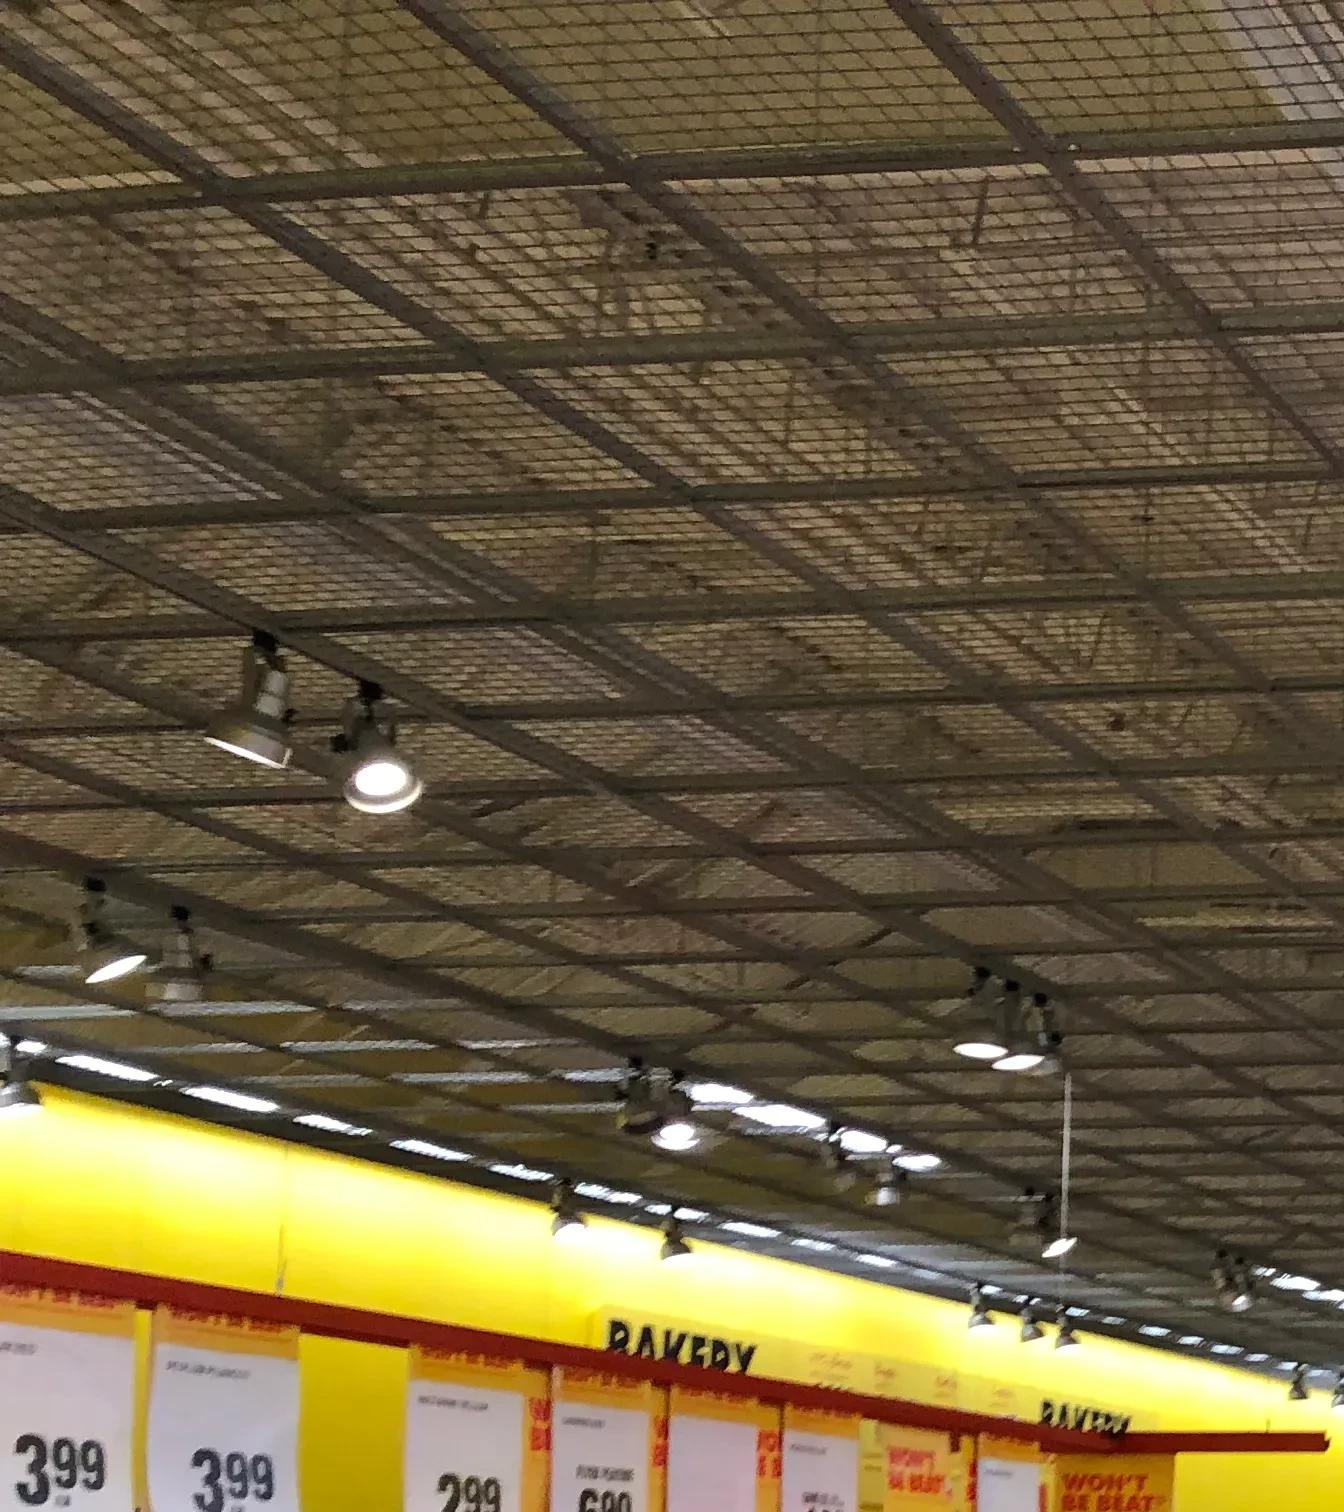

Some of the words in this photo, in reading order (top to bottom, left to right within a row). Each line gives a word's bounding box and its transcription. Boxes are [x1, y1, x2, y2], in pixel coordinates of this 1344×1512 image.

[607, 1319, 756, 1375] BAKERY
[1061, 1473, 1149, 1492] WON'T
[1061, 1495, 1090, 1512] BE
